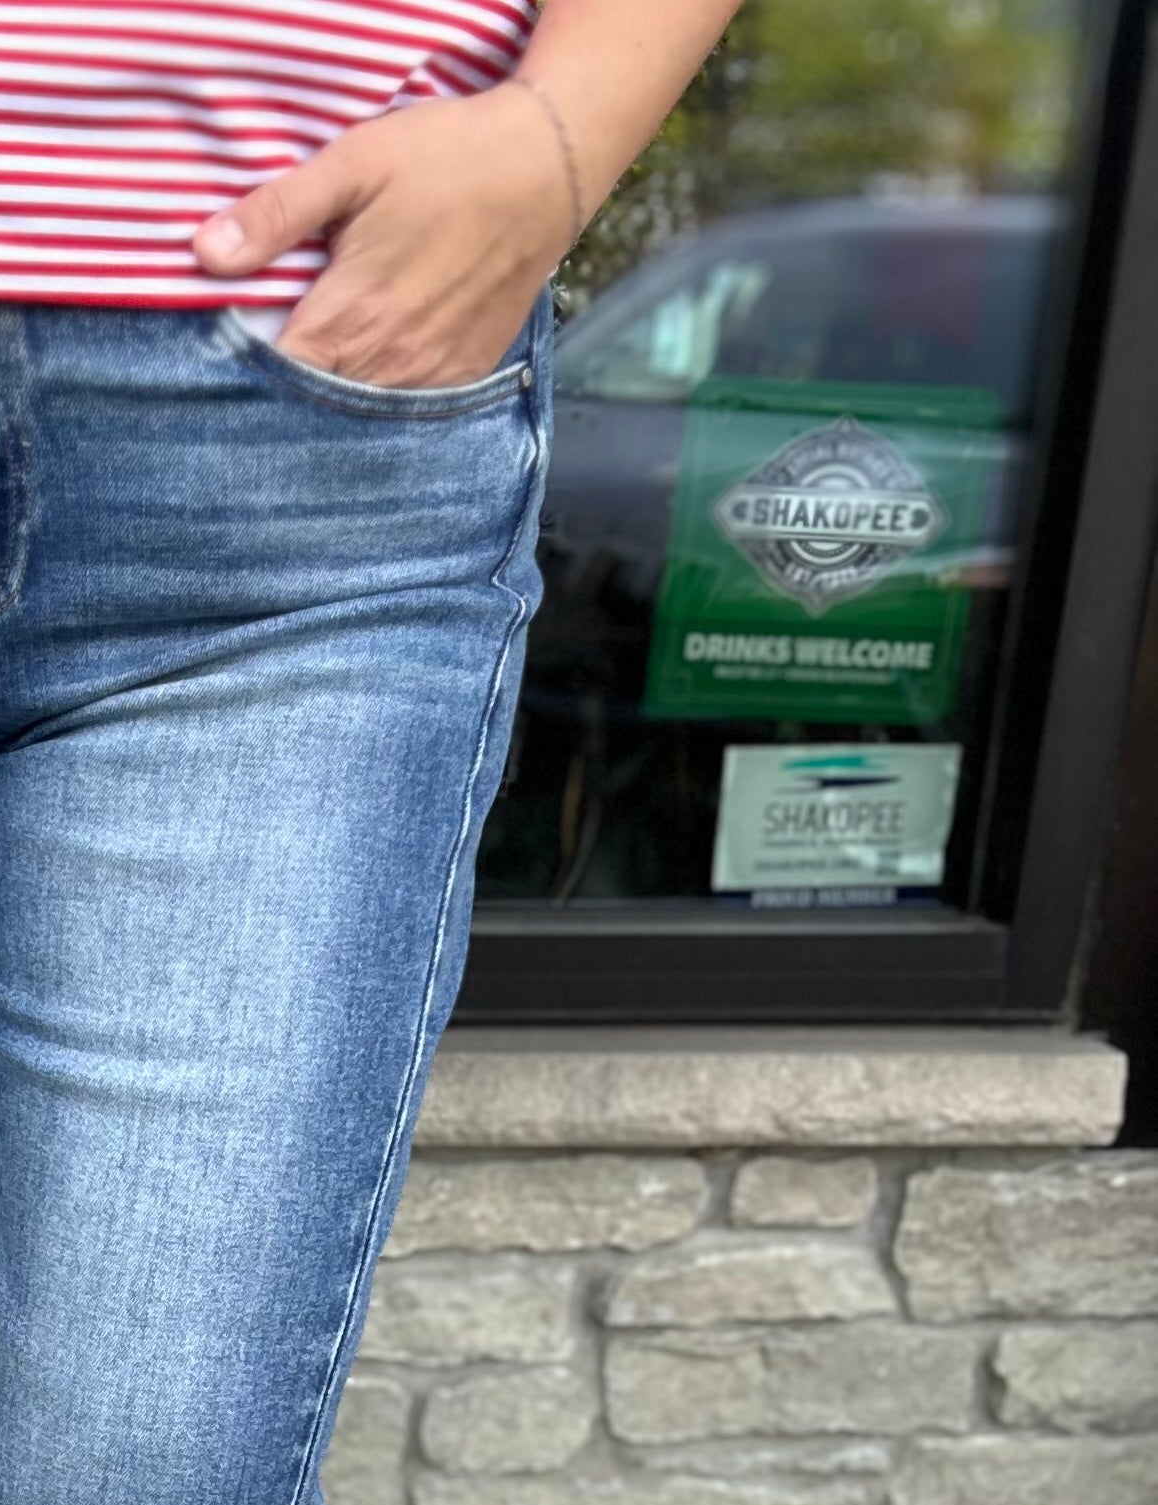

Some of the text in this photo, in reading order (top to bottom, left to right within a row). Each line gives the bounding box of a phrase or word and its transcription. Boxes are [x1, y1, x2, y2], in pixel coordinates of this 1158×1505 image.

[752, 498, 909, 532] SHAKOPEE
[683, 632, 934, 670] DRINKS WELCOME
[762, 801, 908, 834] SHAKOPEE
